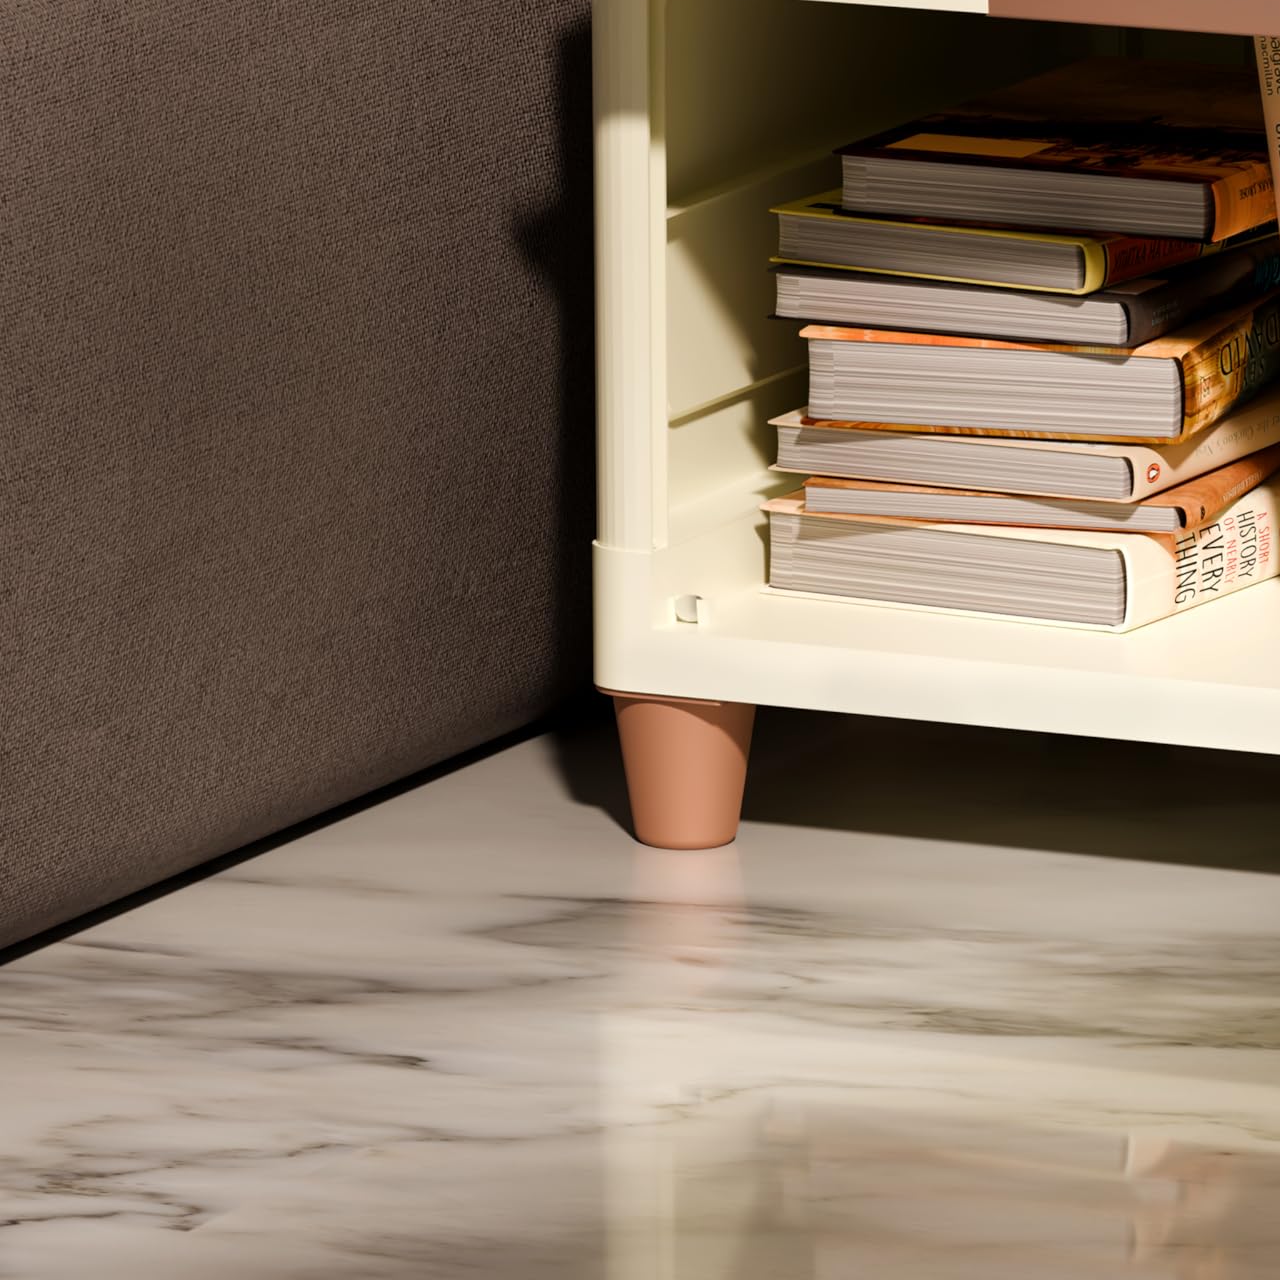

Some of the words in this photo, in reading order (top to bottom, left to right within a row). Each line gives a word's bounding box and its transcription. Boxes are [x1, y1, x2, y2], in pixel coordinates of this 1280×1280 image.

[1223, 517, 1236, 531] OF
[1256, 511, 1268, 520] A
[1199, 523, 1225, 593] EVERY
[1224, 539, 1237, 583] NEARLY
[1236, 510, 1257, 577] HISTORY
[1258, 526, 1271, 564] SHORT
[1174, 532, 1199, 604] THING
